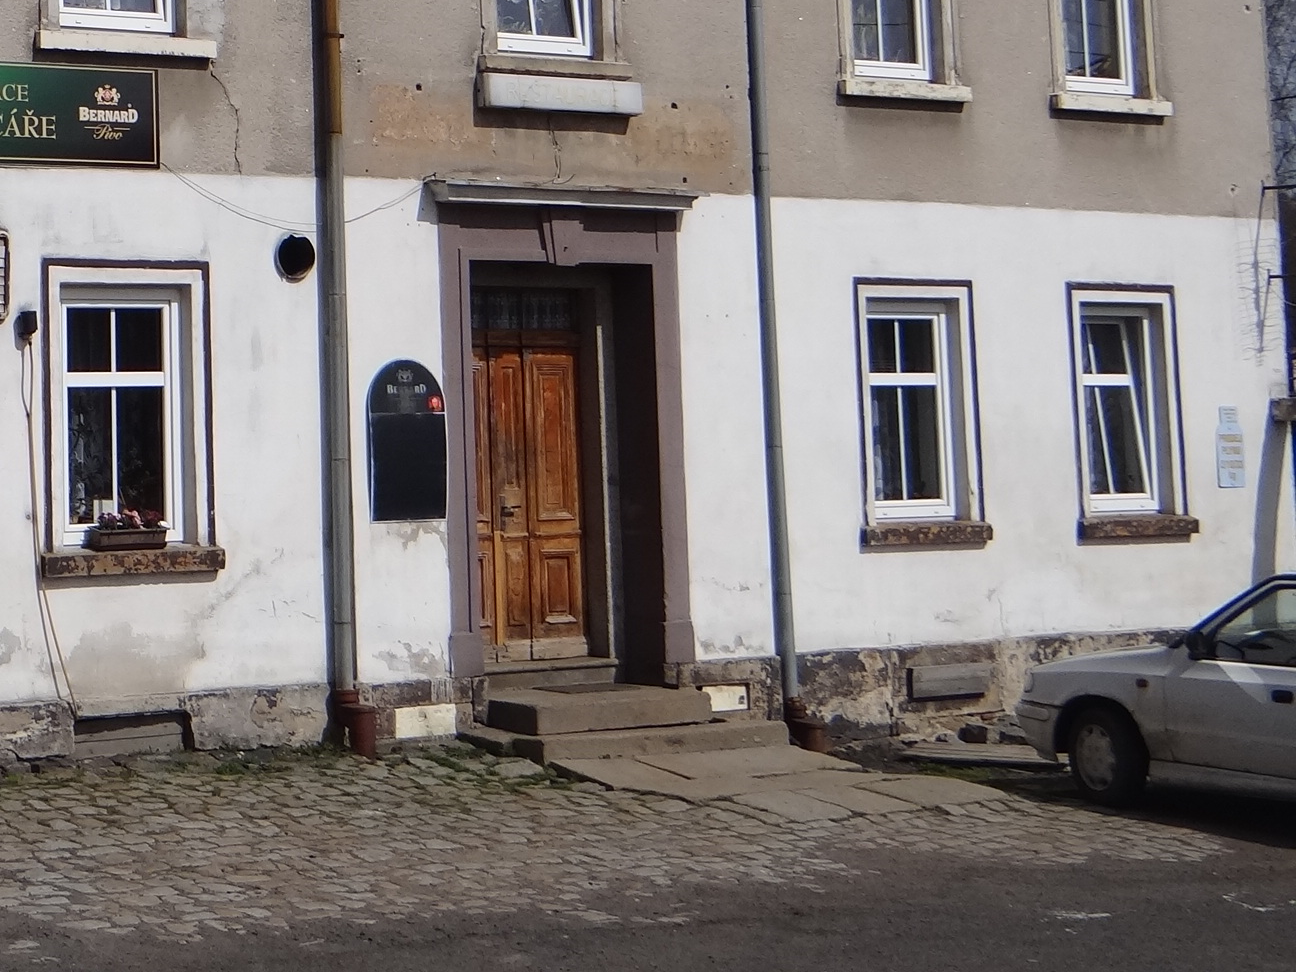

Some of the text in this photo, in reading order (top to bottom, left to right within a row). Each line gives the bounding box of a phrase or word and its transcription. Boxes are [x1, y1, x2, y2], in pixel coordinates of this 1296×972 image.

[78, 106, 139, 124] BERNARD
[93, 123, 124, 141] Pivo
[387, 383, 426, 394] BERD
